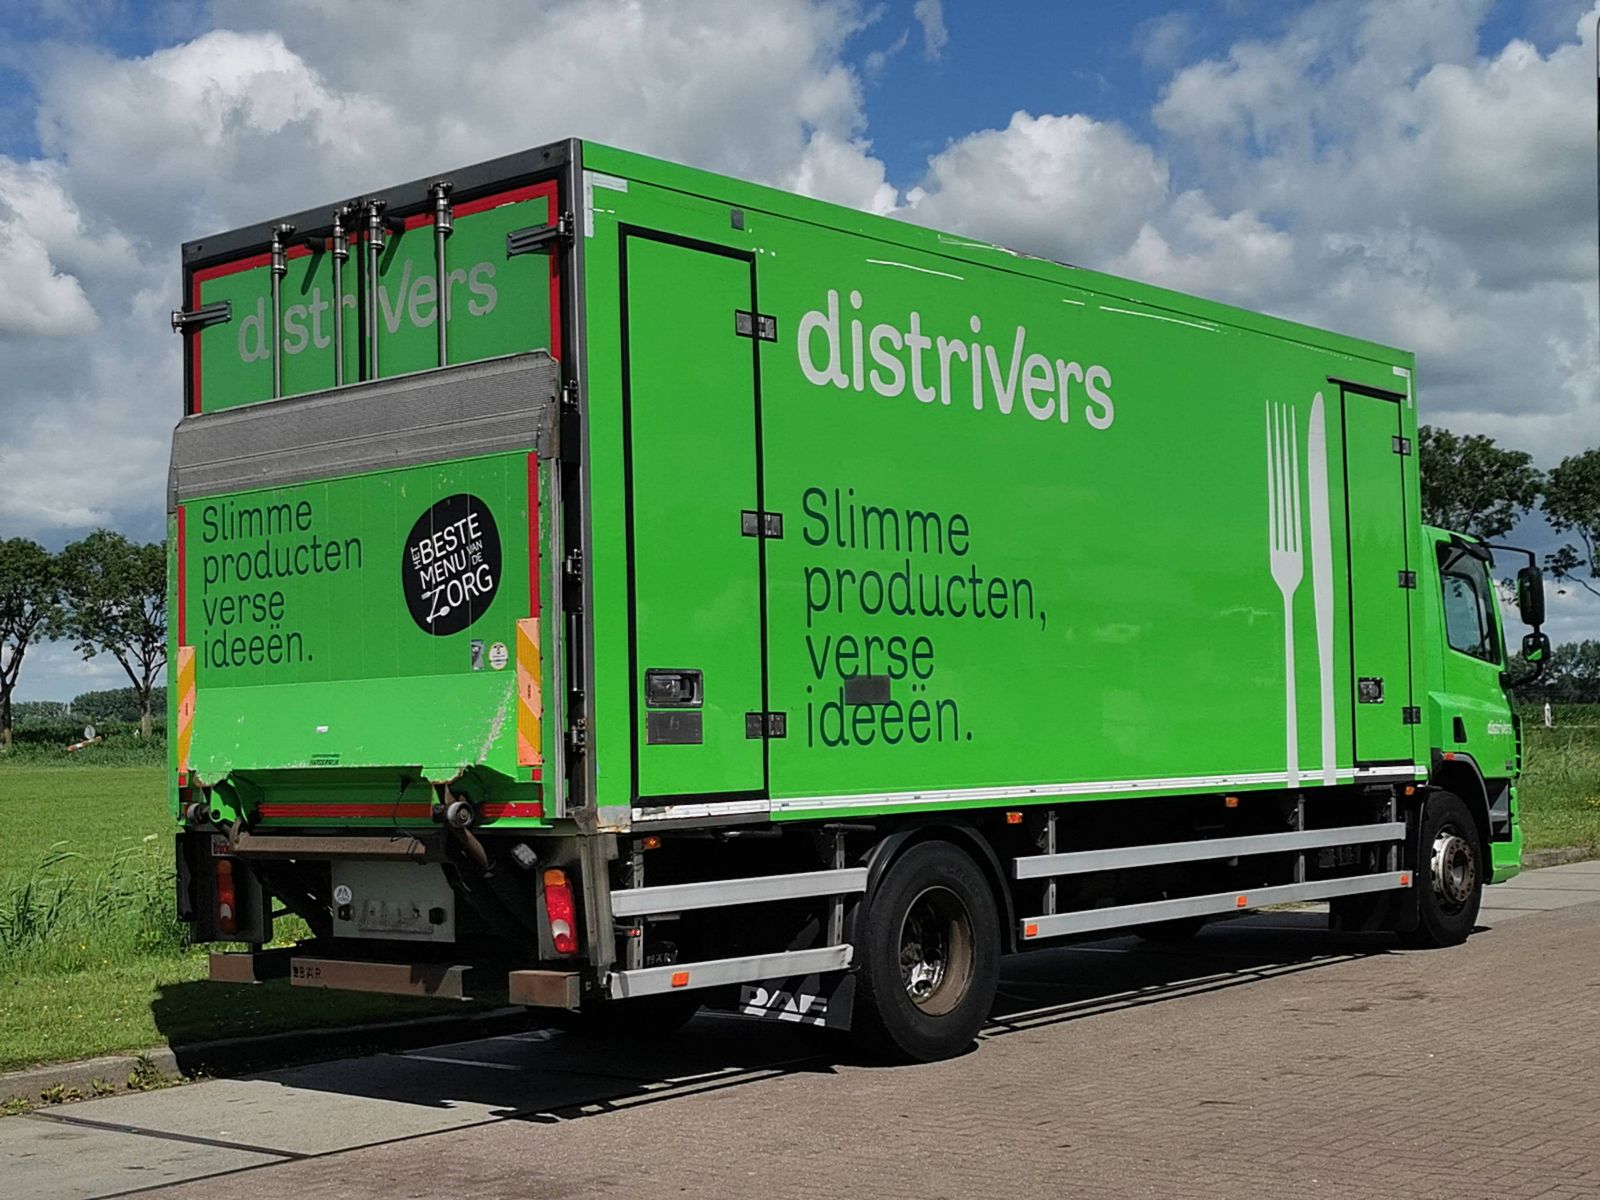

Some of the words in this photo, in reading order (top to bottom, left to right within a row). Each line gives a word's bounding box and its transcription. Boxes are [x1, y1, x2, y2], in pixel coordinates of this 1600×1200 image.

[238, 259, 498, 363] dstvers
[203, 500, 312, 543] Slimme
[410, 546, 422, 570] HET
[419, 512, 482, 565] BESTE
[802, 487, 970, 556] Slimme
[203, 534, 362, 595] producten
[420, 549, 467, 589] MENU
[466, 539, 483, 555] VAN
[471, 552, 483, 565] DE
[202, 591, 285, 626] verse
[421, 564, 493, 623] ZORG
[804, 558, 1046, 631] producten,
[204, 623, 313, 669] ideeën.
[805, 635, 935, 680] verse
[806, 683, 973, 748] ideeën.
[740, 984, 828, 1014] DAF
